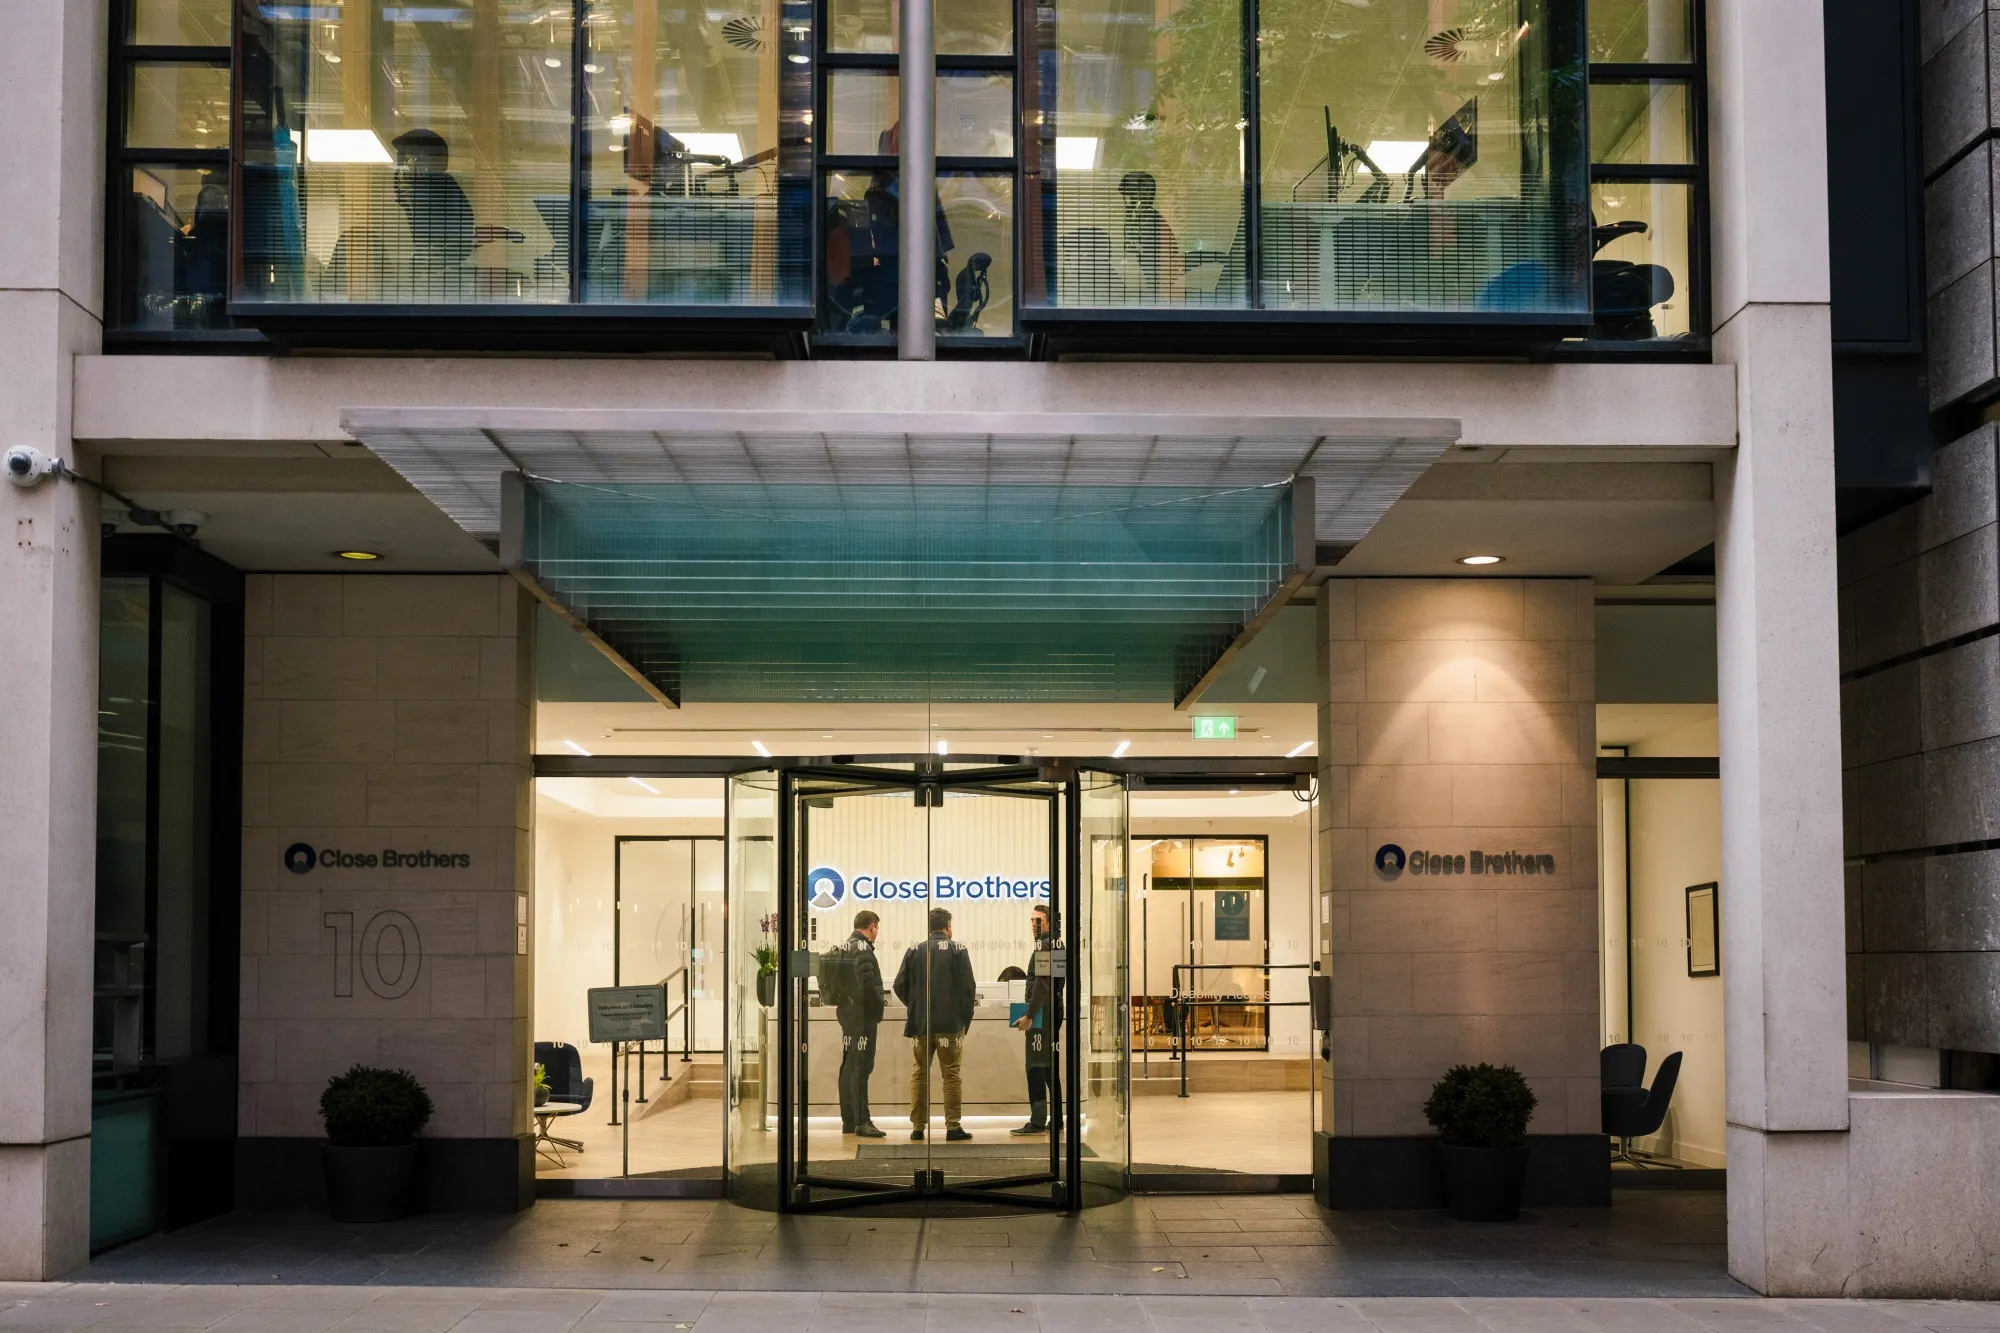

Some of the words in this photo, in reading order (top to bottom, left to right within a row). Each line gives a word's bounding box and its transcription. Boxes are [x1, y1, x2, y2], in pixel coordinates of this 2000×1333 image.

[320, 849, 378, 868] Close
[383, 849, 470, 868] Brothers
[1409, 850, 1465, 872] Close
[1470, 850, 1555, 872] Brothers
[852, 876, 928, 899] Close
[936, 875, 1050, 899] Brothers
[1051, 939, 1062, 949] 10
[1190, 940, 1203, 950] 10
[324, 909, 422, 999] 10
[1170, 988, 1221, 1002] Disability
[1227, 990, 1272, 999] Access
[552, 1040, 564, 1049] 10
[1051, 1042, 1060, 1051] 10
[1190, 1037, 1202, 1046] 10
[1238, 1037, 1250, 1046] 10
